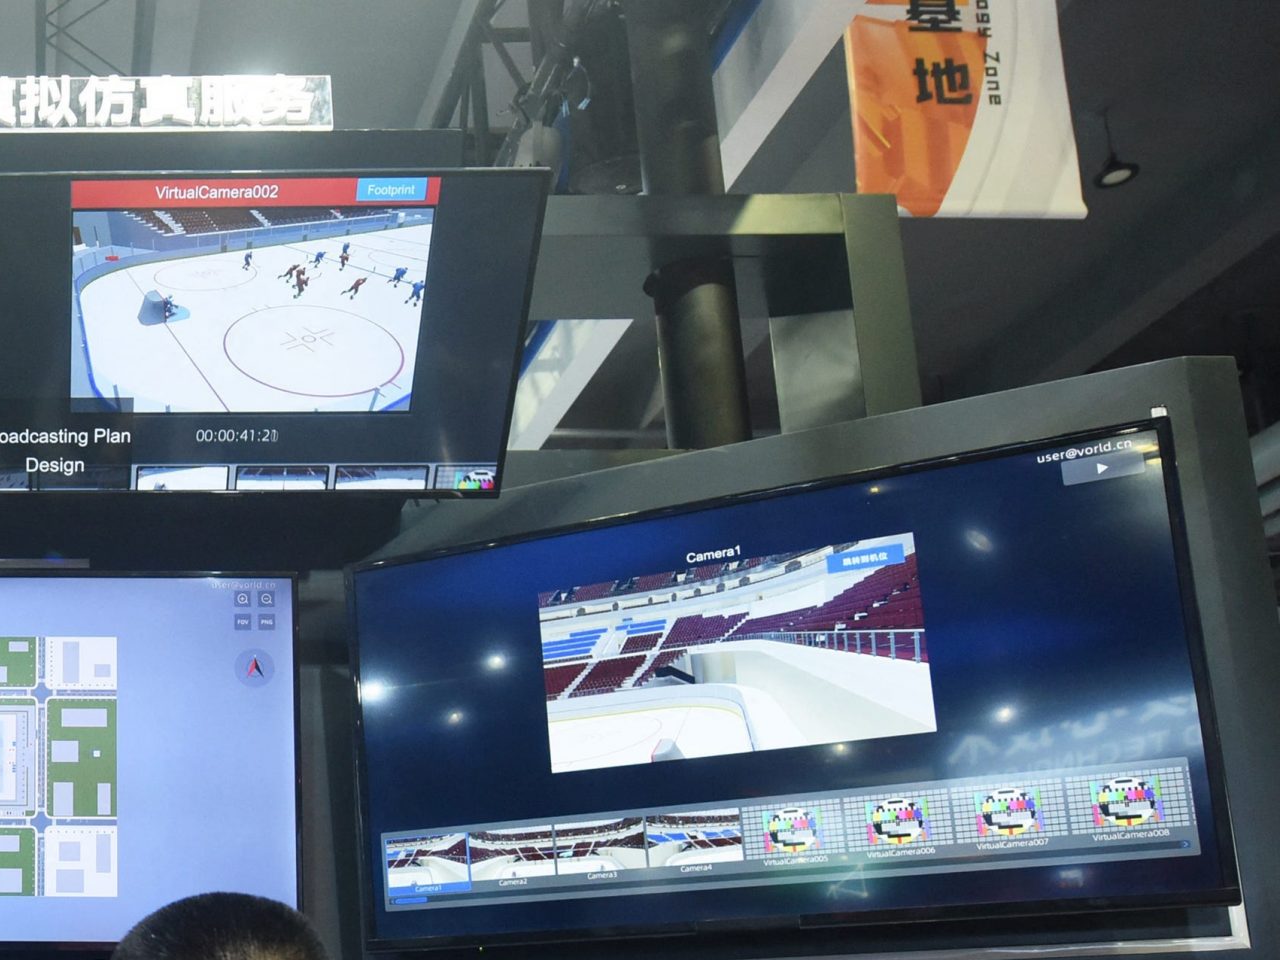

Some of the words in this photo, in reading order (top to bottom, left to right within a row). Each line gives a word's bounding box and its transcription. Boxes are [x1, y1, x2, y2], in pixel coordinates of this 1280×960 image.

[983, 51, 1001, 105] Zone
[155, 185, 279, 200] VirtualCamera002
[367, 184, 415, 197] Footprint
[94, 428, 131, 444] Plan
[1037, 440, 1132, 464] user@vorld.cn
[25, 457, 85, 476] Design
[686, 545, 742, 564] Camera1
[1092, 828, 1170, 842] VirtualCamera008
[976, 837, 1049, 851] VirtualCamera007
[866, 846, 936, 859] VirtualCamera006
[763, 855, 829, 867] VirtualCamera005
[680, 864, 713, 874] Camera4
[498, 878, 528, 887] Camera2
[587, 872, 618, 881] Camera3
